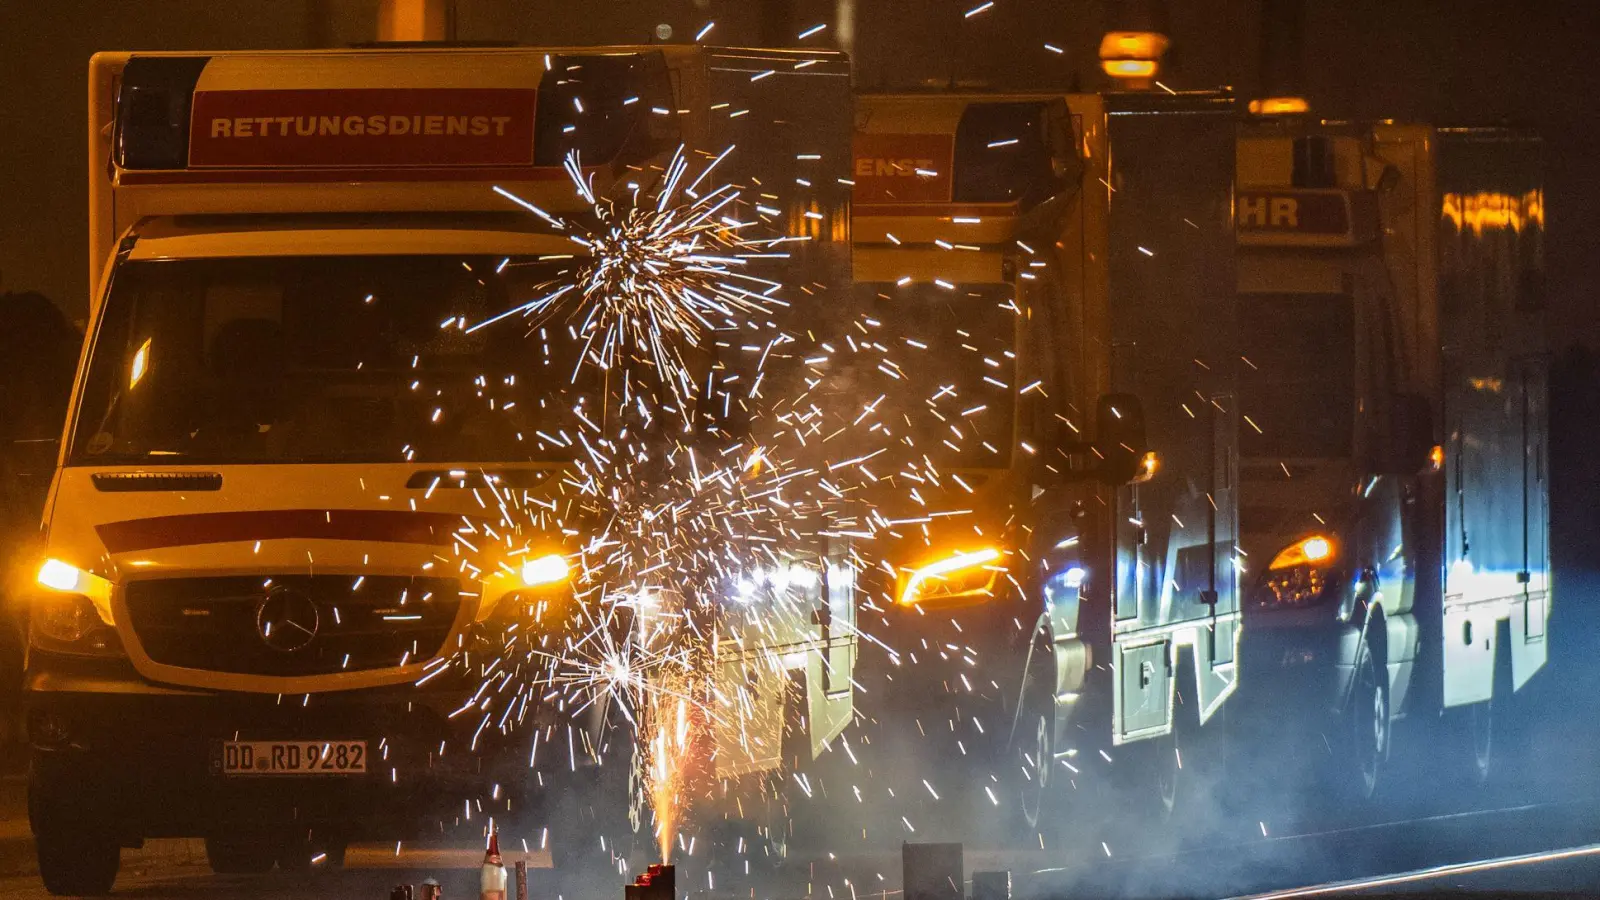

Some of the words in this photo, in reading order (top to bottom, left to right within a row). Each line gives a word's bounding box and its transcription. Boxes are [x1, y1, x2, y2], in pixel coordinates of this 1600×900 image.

[211, 115, 511, 138] RETTUNGSDIENST
[855, 158, 933, 177] ENST
[1239, 196, 1298, 226] HR
[226, 744, 253, 770] DD
[271, 744, 300, 770] RD
[306, 743, 363, 770] 9282
